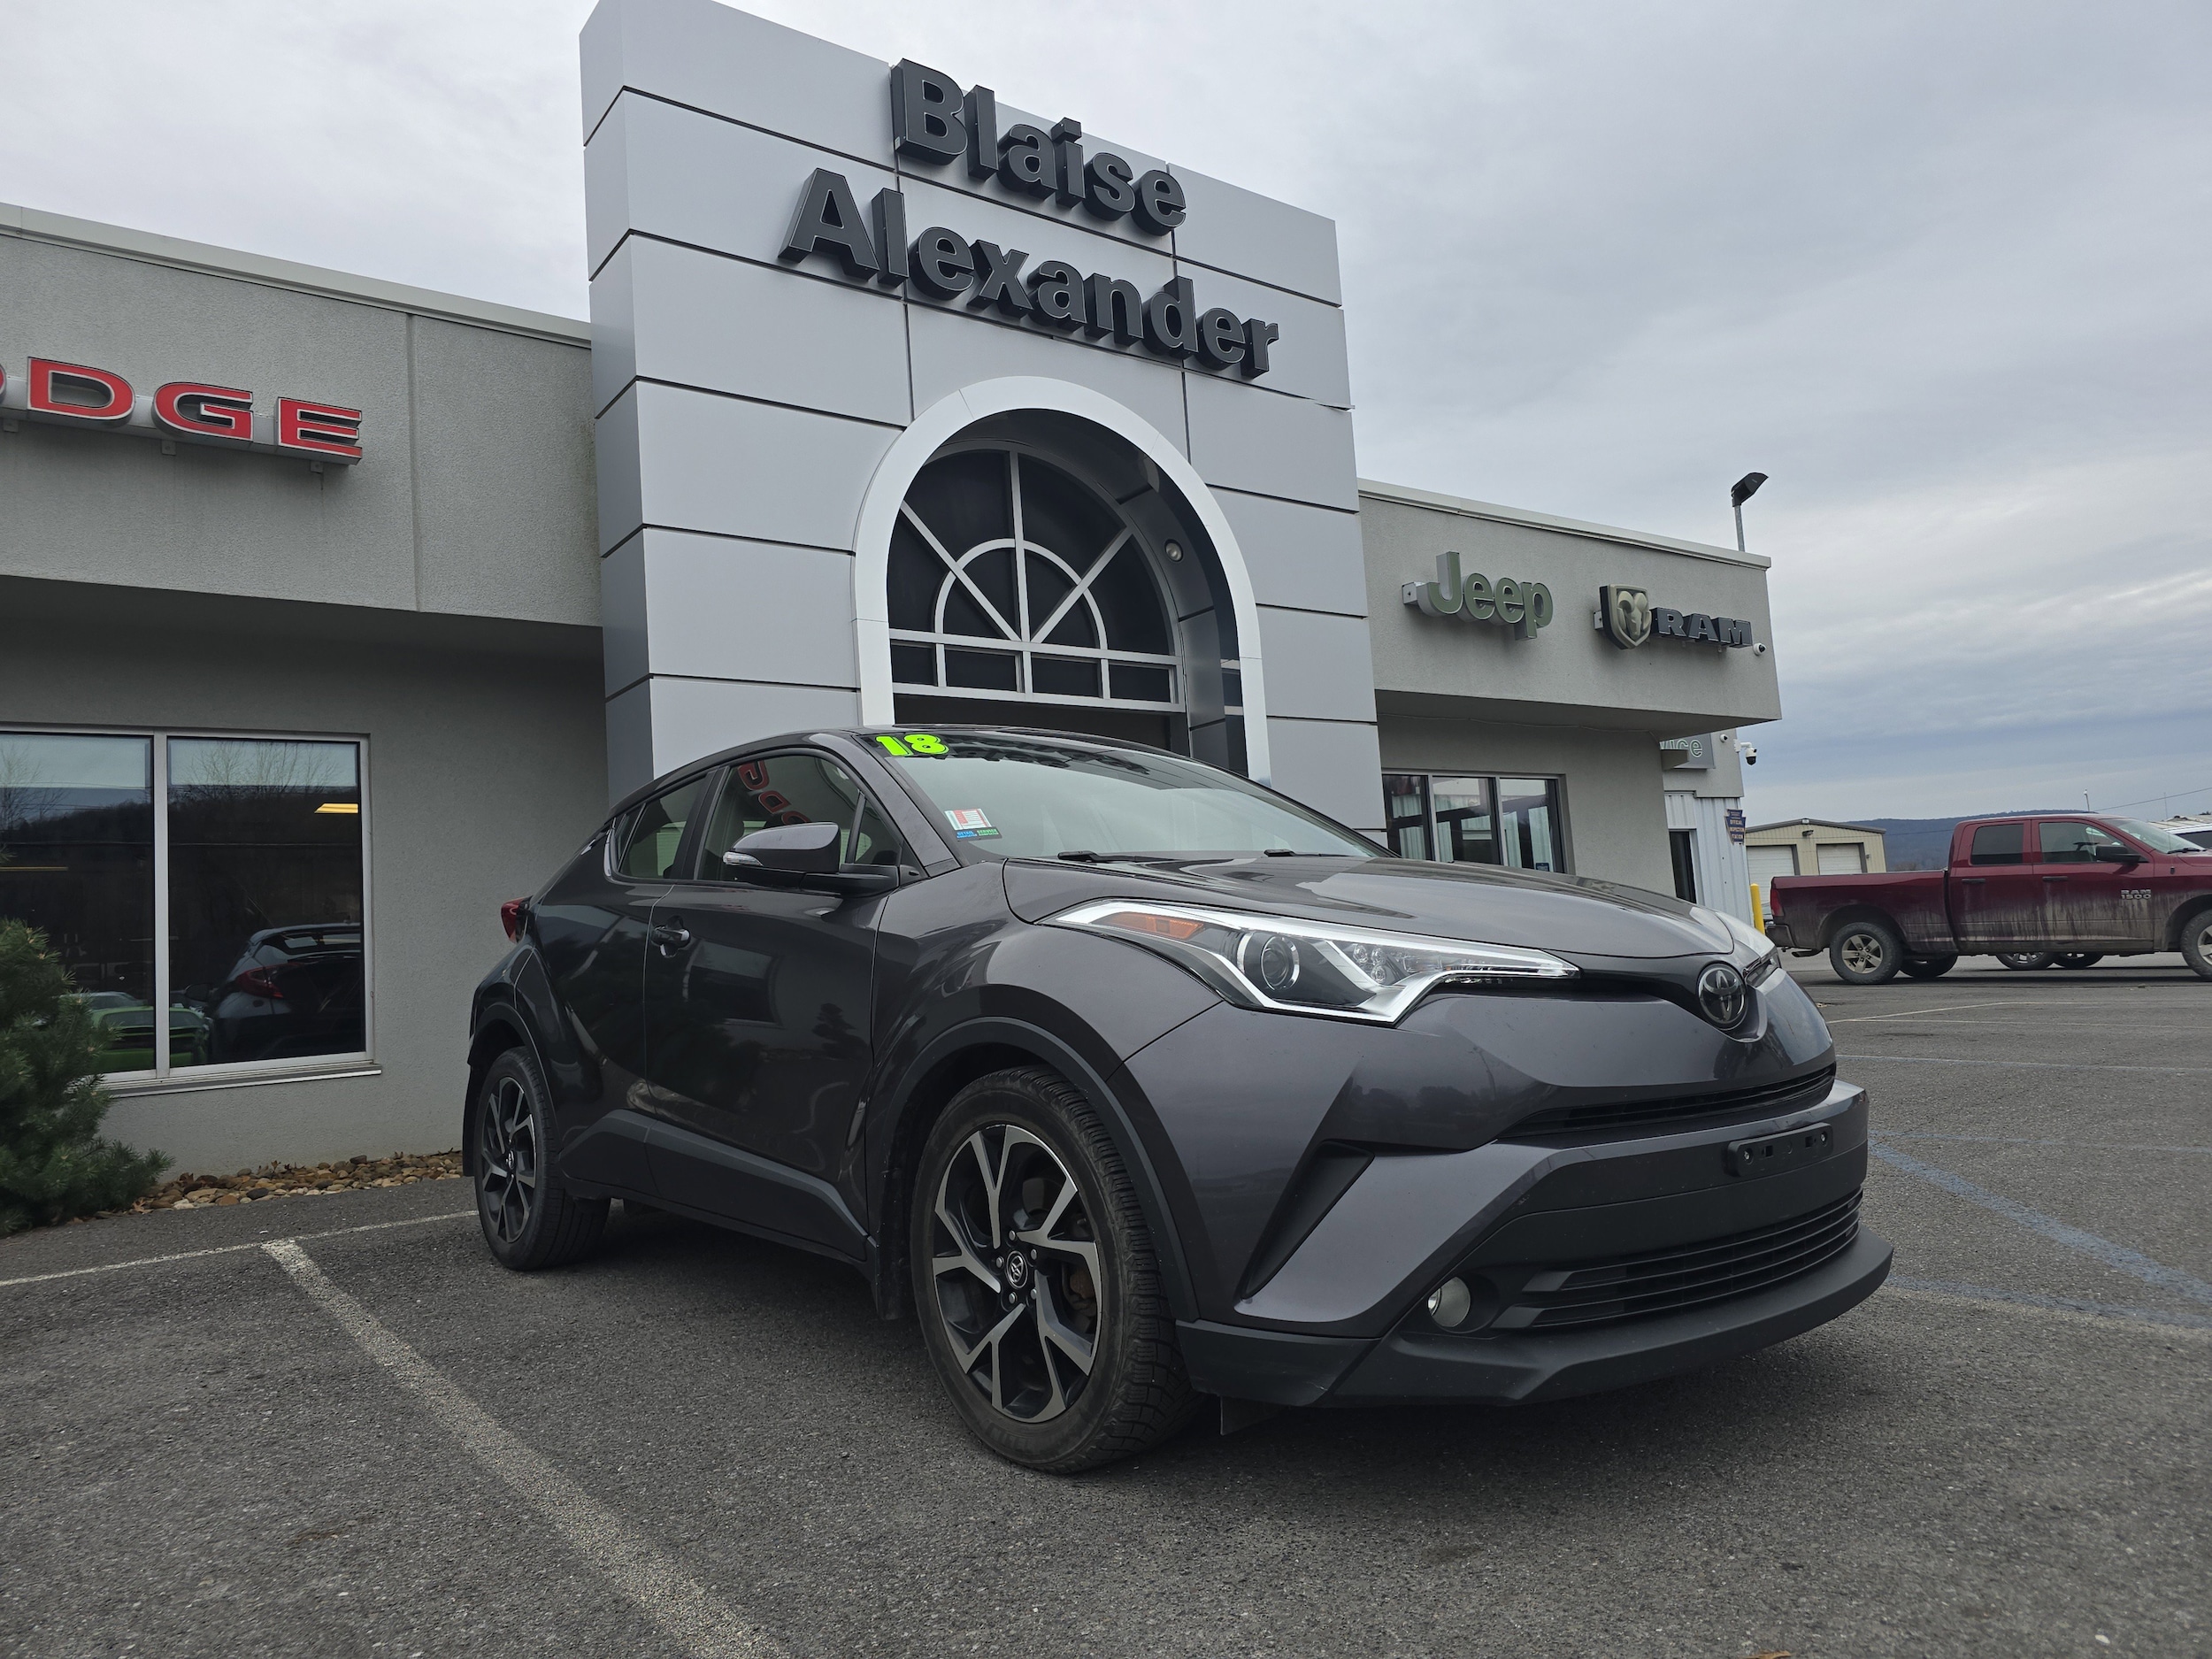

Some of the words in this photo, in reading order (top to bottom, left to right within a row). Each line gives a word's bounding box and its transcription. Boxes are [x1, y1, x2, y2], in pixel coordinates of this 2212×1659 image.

[890, 58, 1187, 236] Blaise
[778, 167, 1279, 380] Alexander
[0, 356, 363, 465] DGE
[1416, 550, 1554, 641] Jeep
[1651, 606, 1753, 649] RAM
[875, 733, 950, 757] 18
